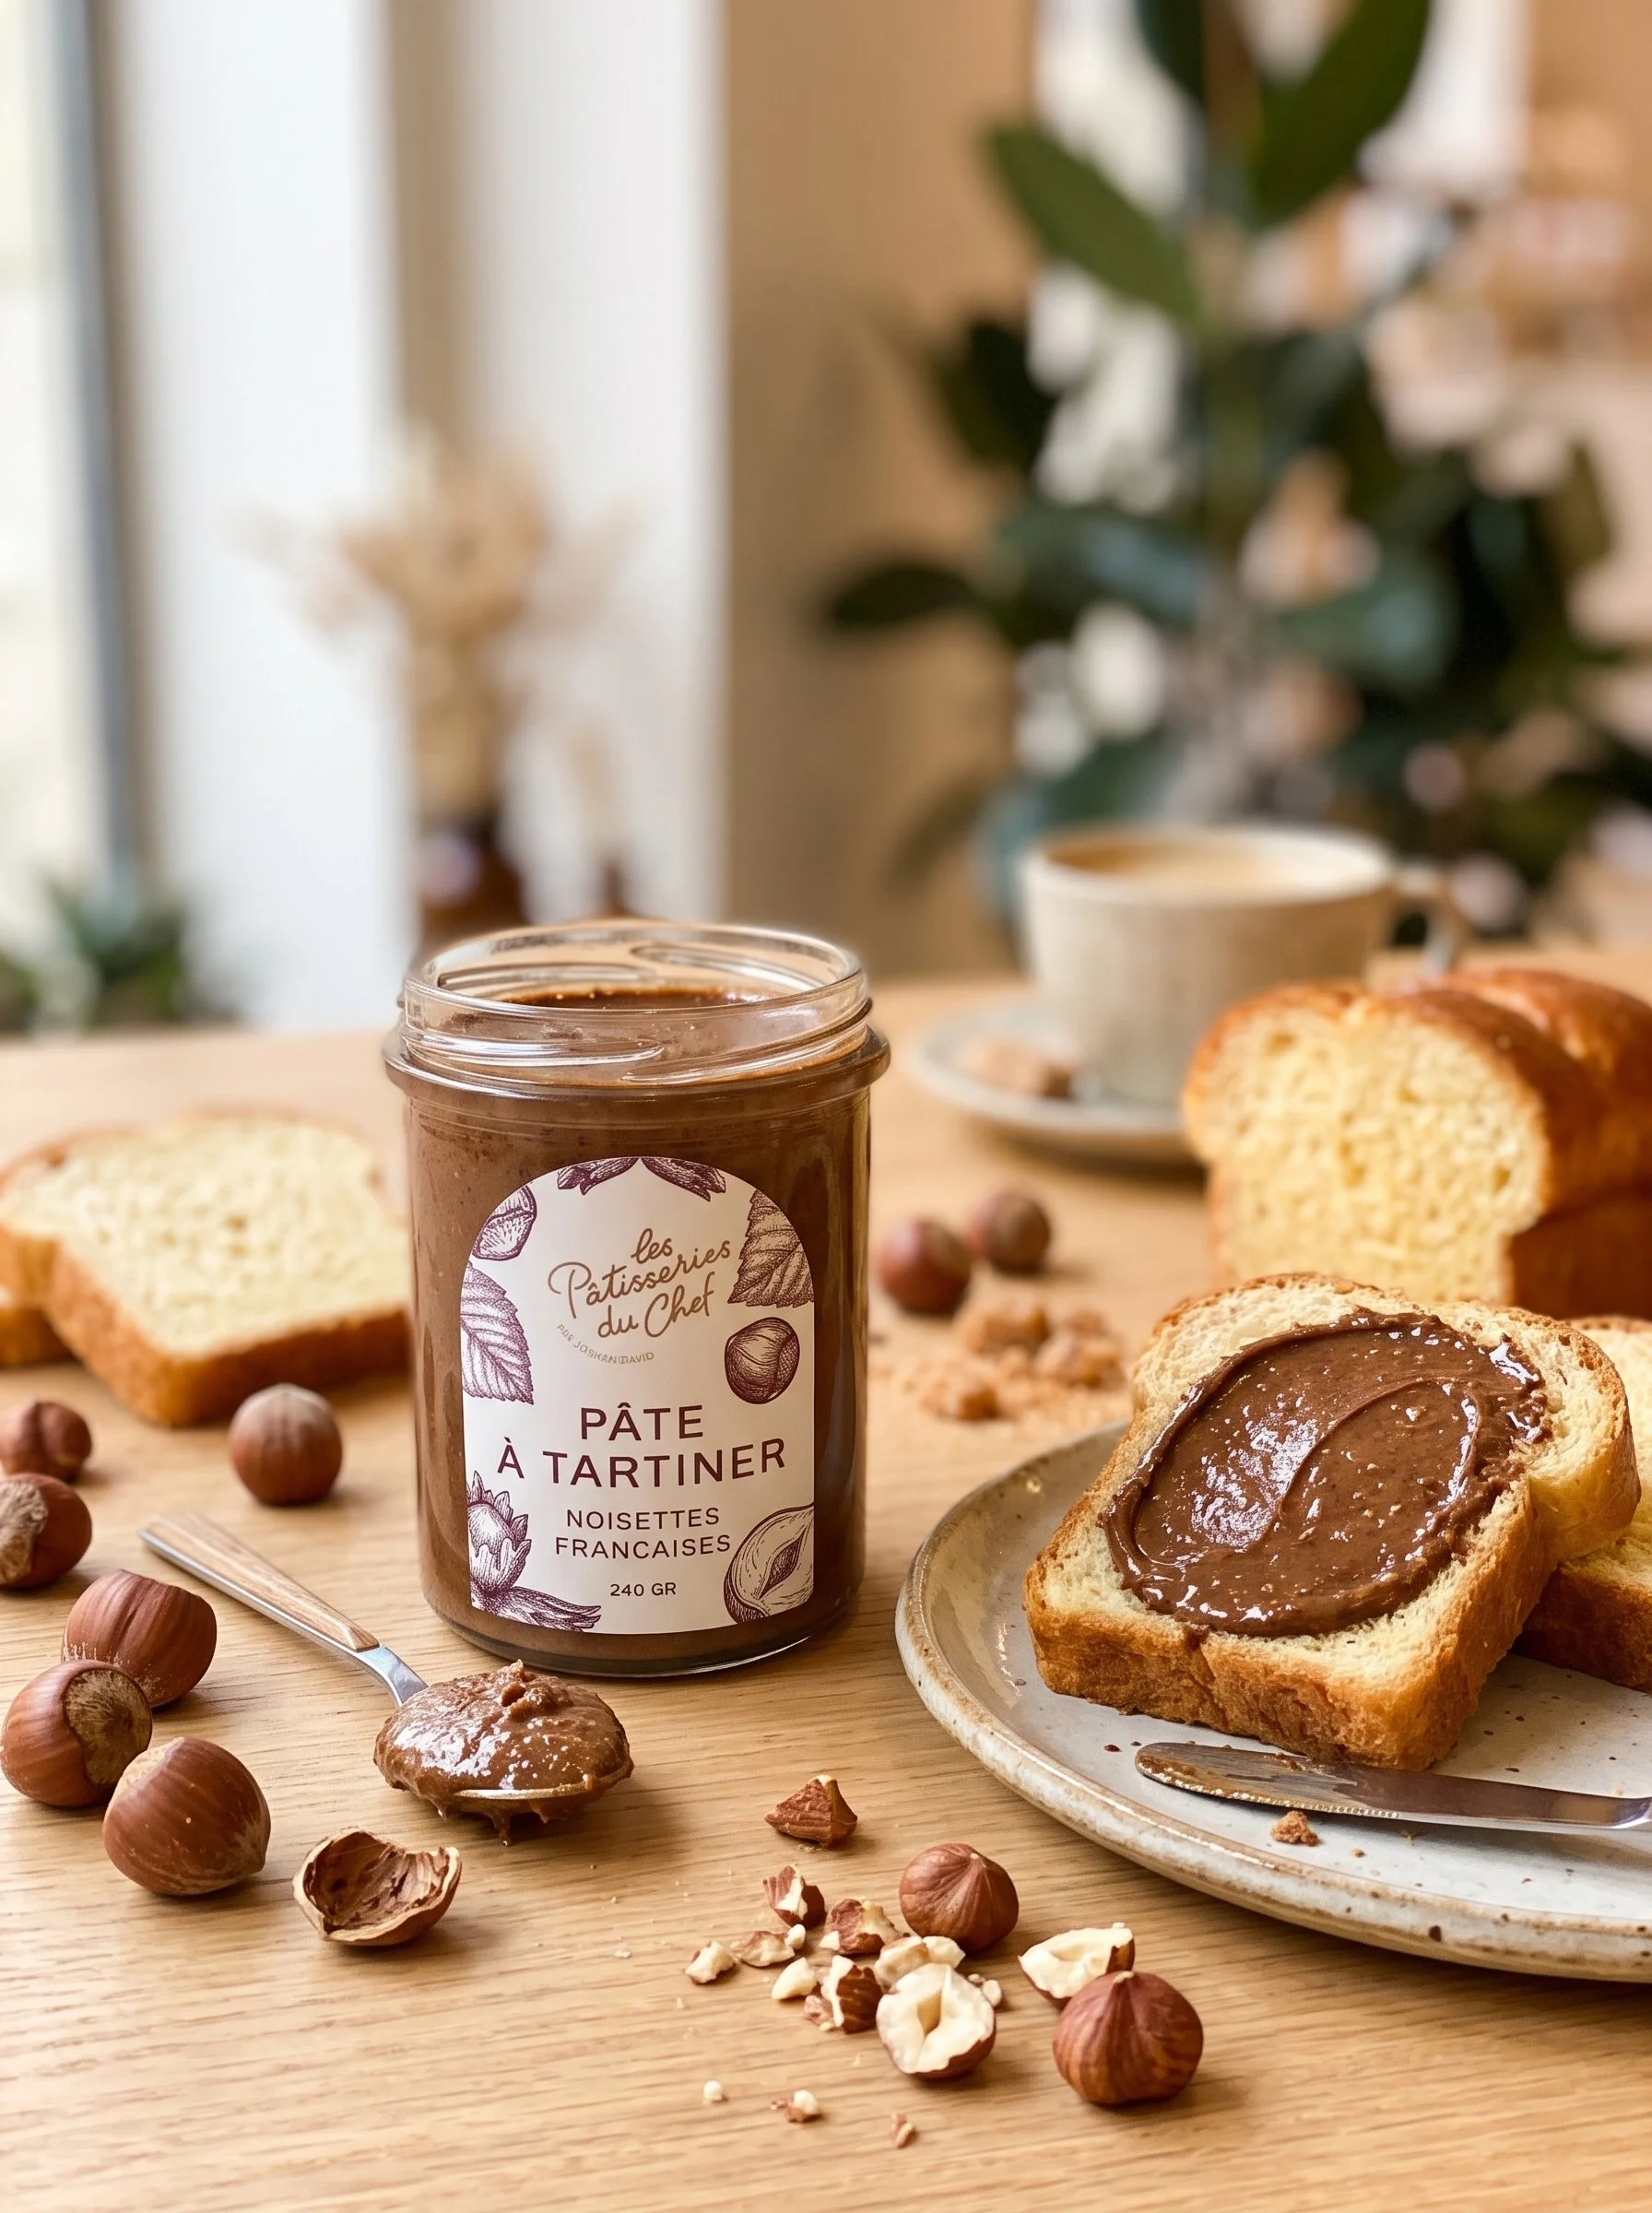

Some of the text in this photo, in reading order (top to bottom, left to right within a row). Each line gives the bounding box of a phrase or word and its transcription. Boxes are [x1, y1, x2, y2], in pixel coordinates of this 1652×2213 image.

[631, 1227, 673, 1264] les
[548, 1239, 731, 1319] Pâtisseries
[597, 1271, 715, 1338] du Chef
[580, 1402, 703, 1441] PÂTE
[497, 1437, 785, 1488] À TARTINER
[566, 1507, 720, 1531] NOISETTES
[555, 1534, 731, 1559] FRANCAISES
[609, 1581, 677, 1597] 240 GR
